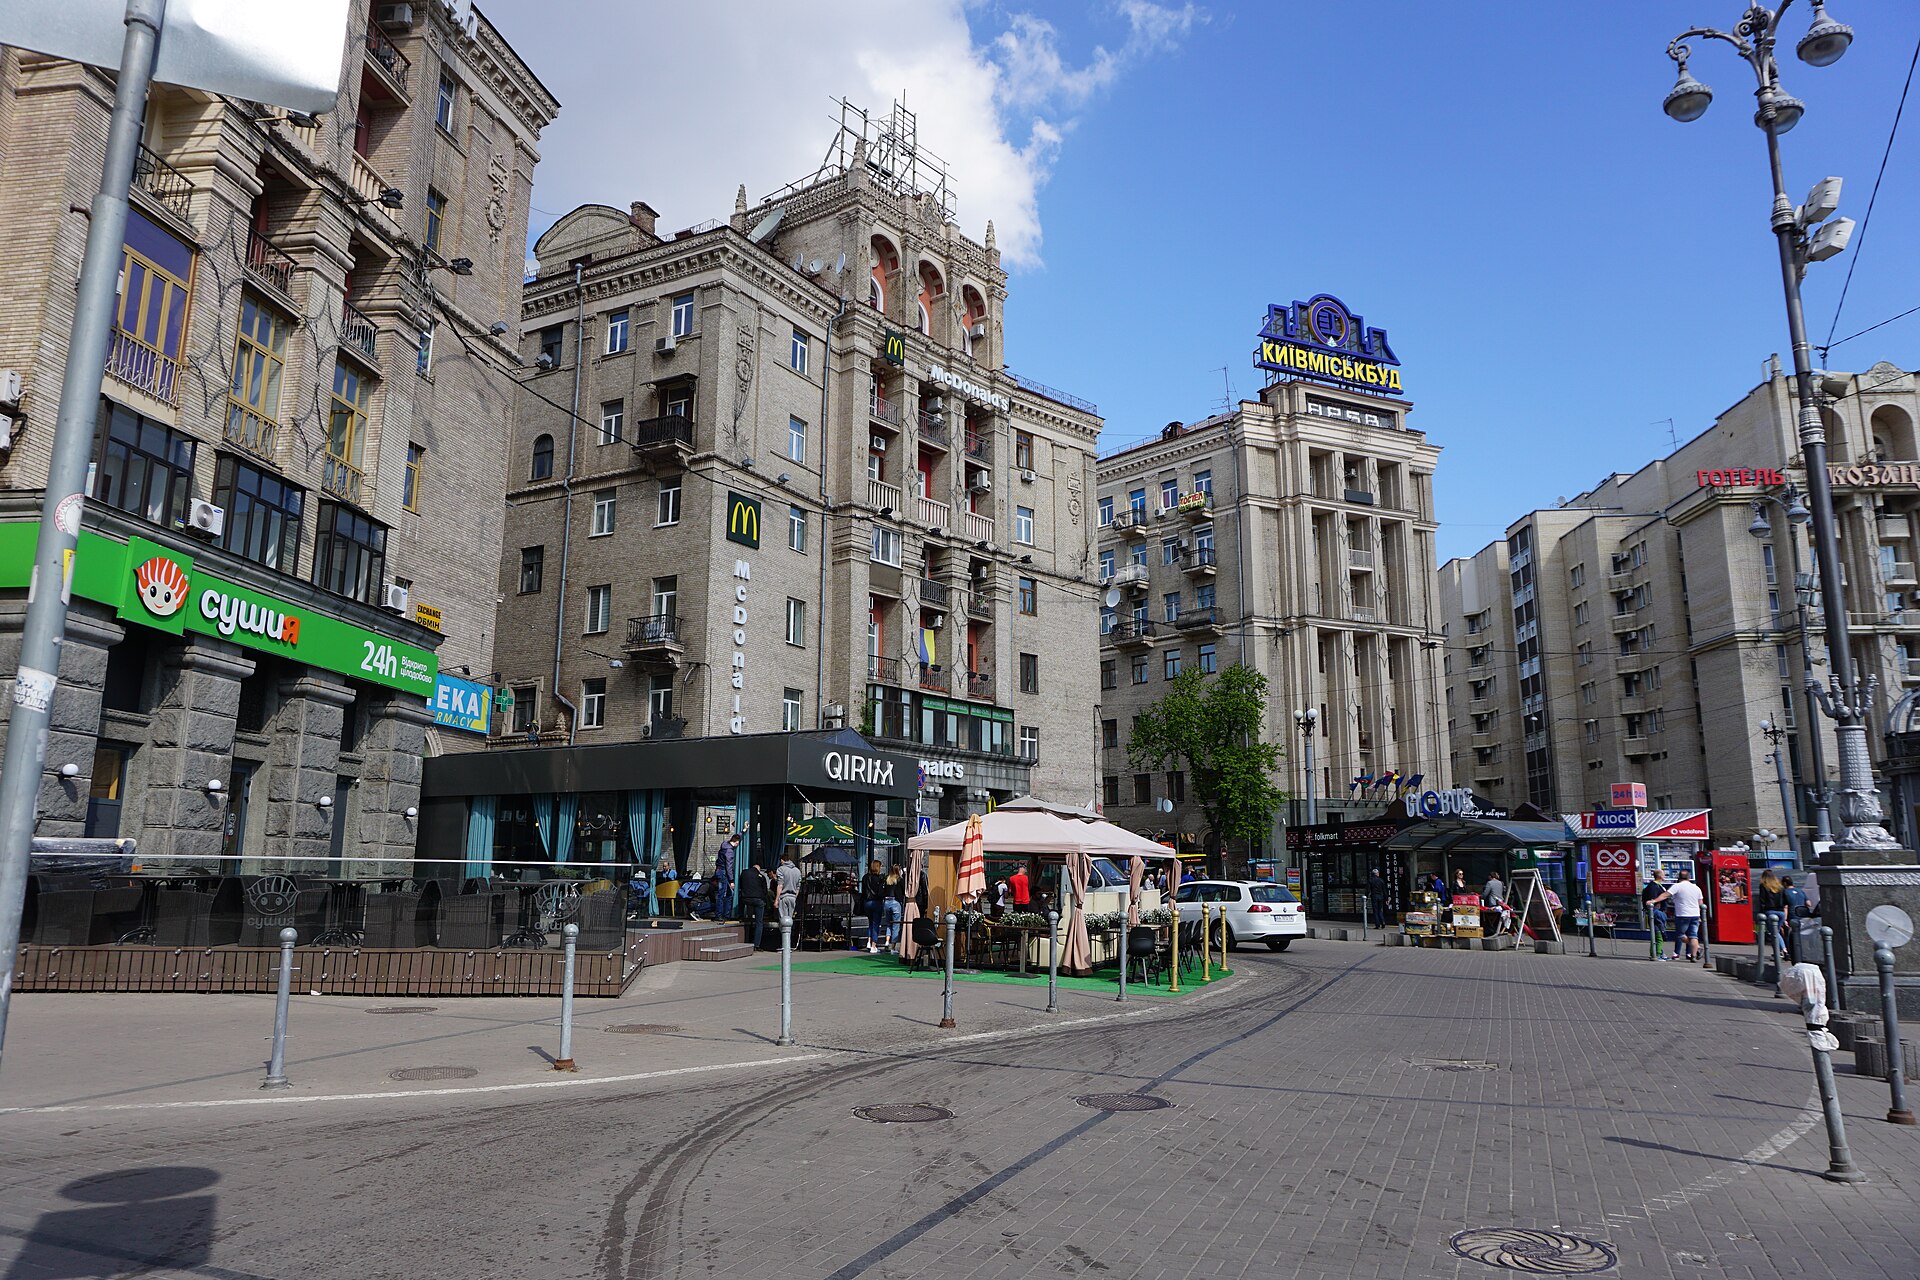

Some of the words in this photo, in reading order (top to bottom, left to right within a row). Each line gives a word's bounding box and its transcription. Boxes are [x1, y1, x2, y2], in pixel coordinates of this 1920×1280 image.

[1262, 341, 1403, 390] КИЇВМІСЬКБУД
[930, 364, 1009, 412] McDonald's
[1697, 467, 1785, 488] ГОТЕЛЬ
[1826, 465, 1920, 489] КОЗАЦ
[201, 589, 301, 645] сушия
[417, 604, 442, 619] EXCHANGE
[417, 616, 440, 630] ОБМІН
[729, 559, 751, 735] McDonald'
[360, 640, 398, 679] 24h
[401, 655, 428, 672] Відкрито
[400, 667, 433, 684] цілодобово
[436, 711, 473, 728] RMACY
[824, 751, 894, 787] QIRIM
[919, 760, 964, 779] nald's
[1405, 787, 1474, 818] GLOBUS
[1314, 832, 1338, 841] folkmart
